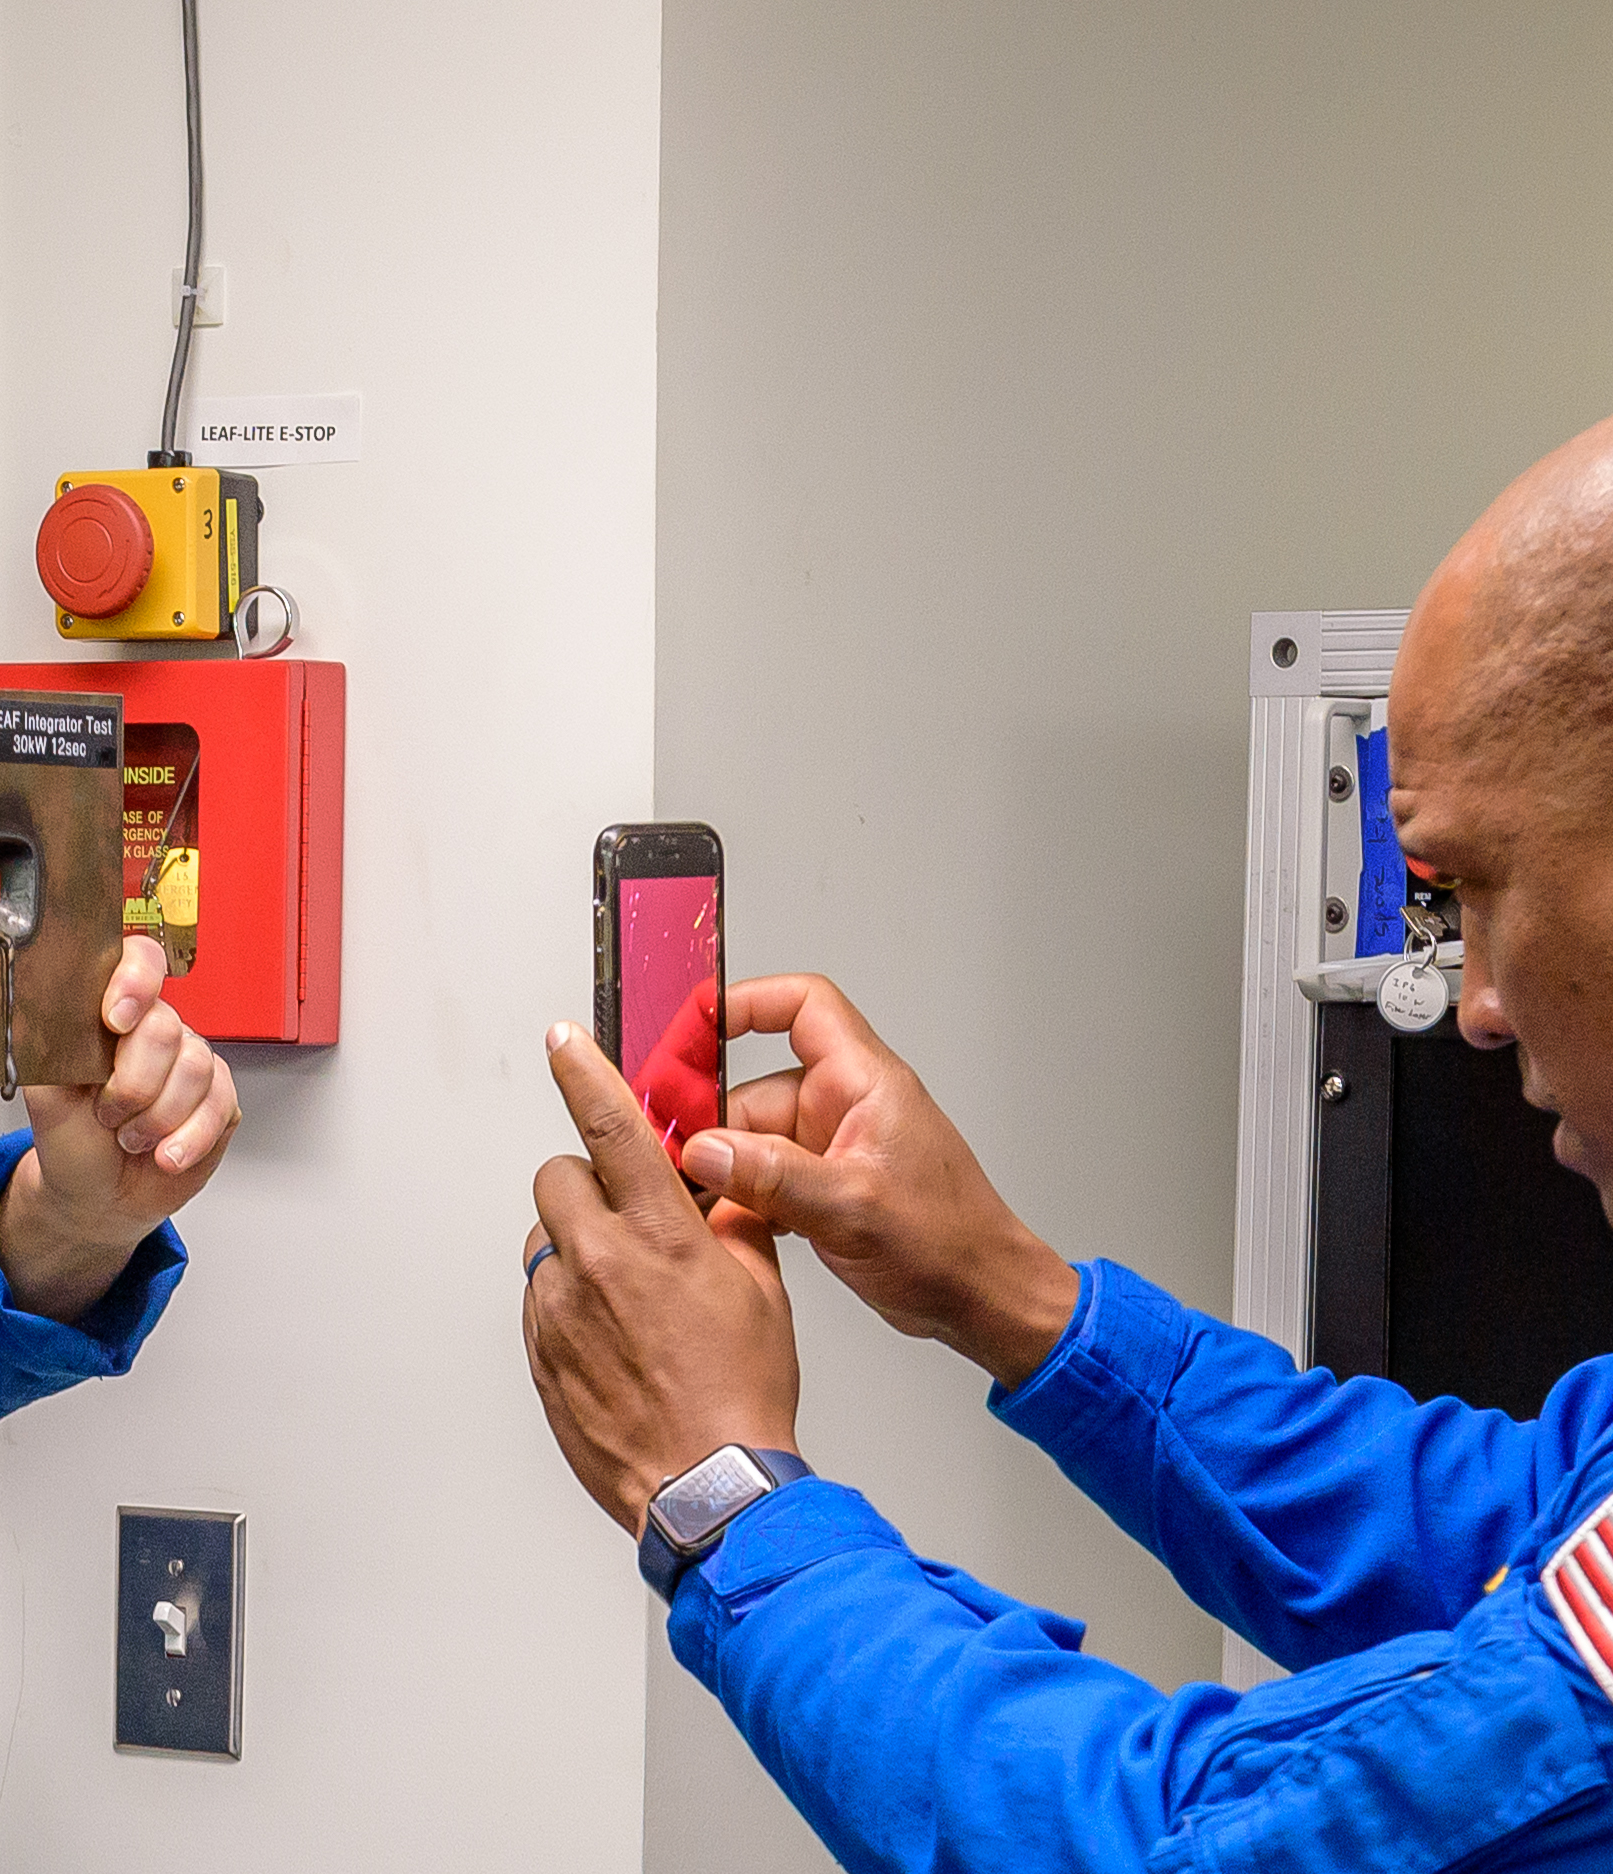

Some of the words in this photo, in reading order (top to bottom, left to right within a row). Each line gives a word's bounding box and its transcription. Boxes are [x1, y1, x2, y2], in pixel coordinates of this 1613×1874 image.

[201, 425, 274, 441] LEAF-LITE
[280, 425, 336, 441] E-STOP
[203, 508, 213, 540] 3
[24, 711, 83, 735] Integrator
[85, 715, 113, 735] Test
[13, 734, 47, 755] 30kW
[51, 737, 87, 758] 12sec
[123, 766, 175, 785] INSIDE
[148, 810, 164, 825] OF
[133, 845, 169, 859] GLASS
